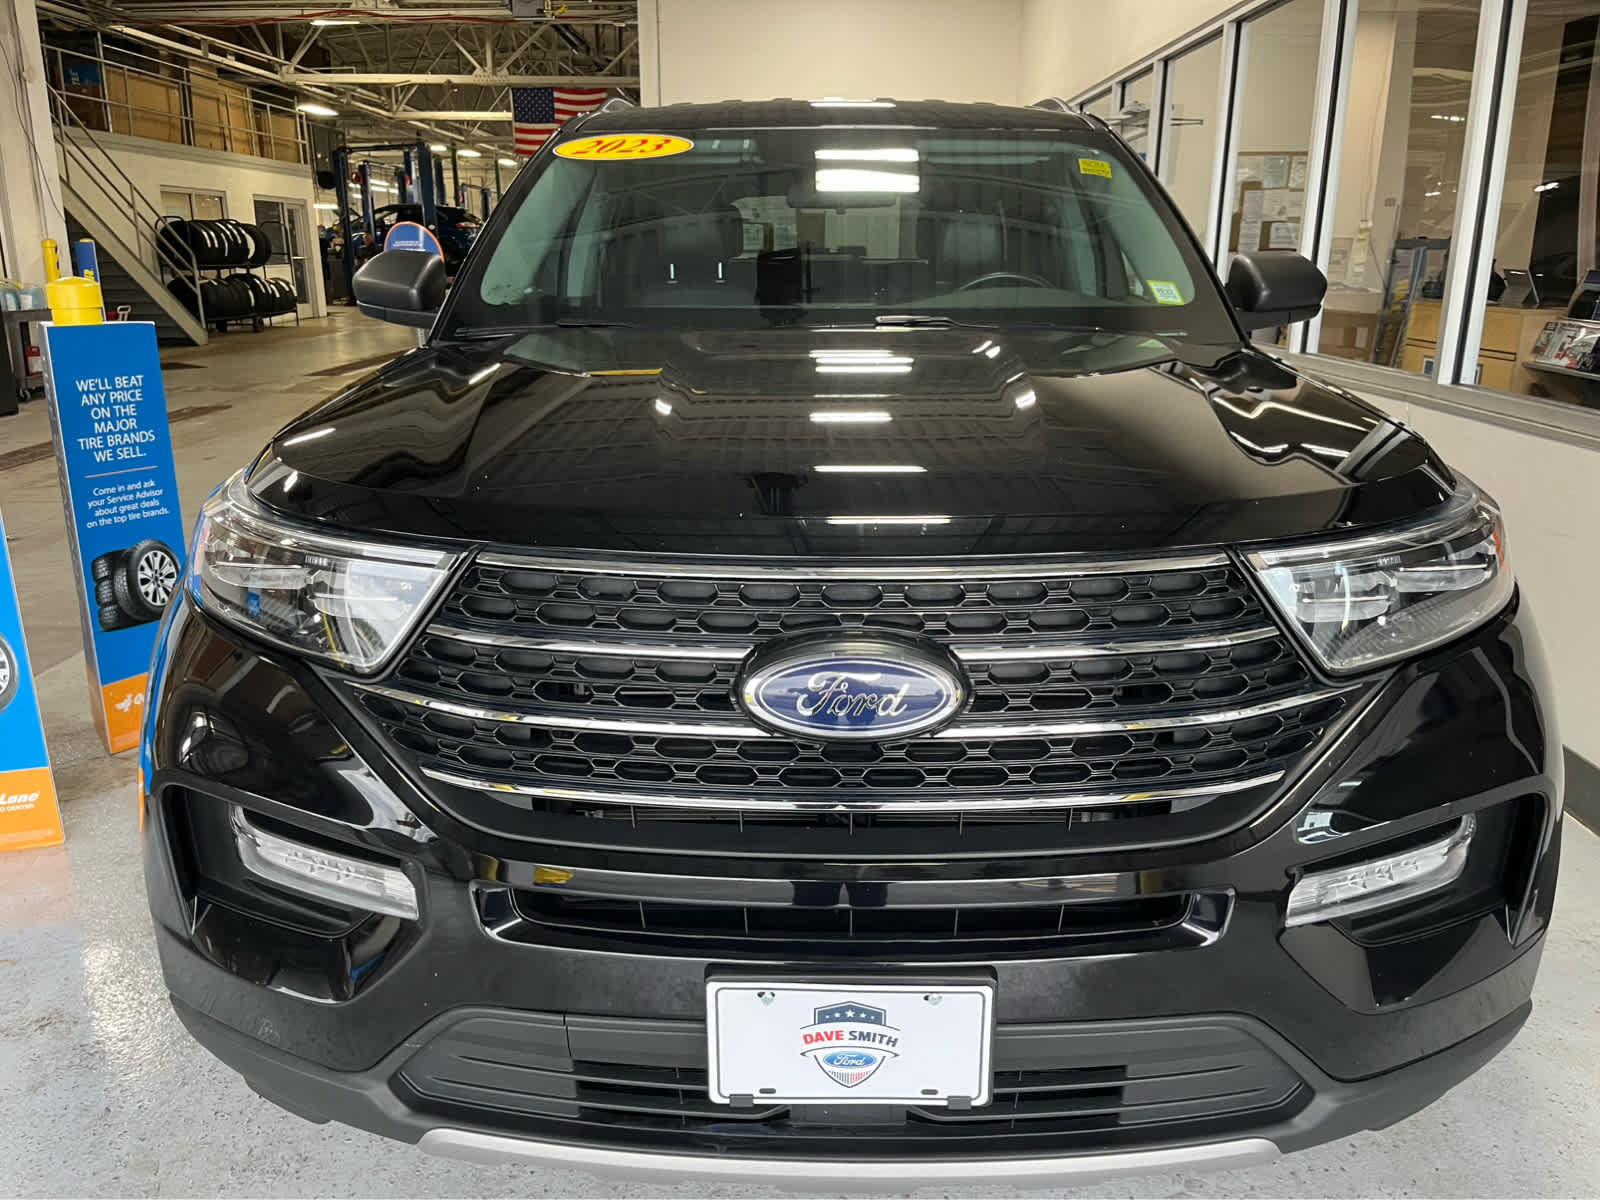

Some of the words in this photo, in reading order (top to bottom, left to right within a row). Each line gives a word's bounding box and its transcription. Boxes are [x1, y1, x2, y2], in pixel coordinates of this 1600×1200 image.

[570, 139, 671, 155] 2023
[76, 378, 112, 392] WE'LL
[115, 375, 144, 388] BEAT
[81, 393, 107, 406] ANY
[110, 389, 143, 403] PRICE
[91, 407, 111, 420] ON
[113, 404, 137, 417] THE
[94, 418, 138, 434] MAJOR
[77, 438, 104, 450] TIRE
[107, 430, 156, 447] BRANDS
[94, 450, 114, 463] WE
[117, 446, 147, 459] SELL.
[93, 486, 116, 497] Come
[118, 484, 125, 492] in
[127, 481, 141, 491] and
[144, 479, 156, 488] ask
[88, 498, 105, 509] your
[107, 493, 134, 505] Service
[136, 488, 164, 500] Advisor
[95, 506, 117, 517] about
[119, 502, 139, 514] great
[140, 499, 160, 509] deals
[99, 516, 112, 526] the
[114, 514, 127, 525] top
[129, 511, 141, 520] tire
[142, 507, 170, 518] brands.
[796, 671, 910, 717] Ford
[0, 793, 39, 805] Lane
[802, 1030, 844, 1045] DAVE
[848, 1030, 898, 1047] SMITH
[833, 1053, 867, 1066] Ford
